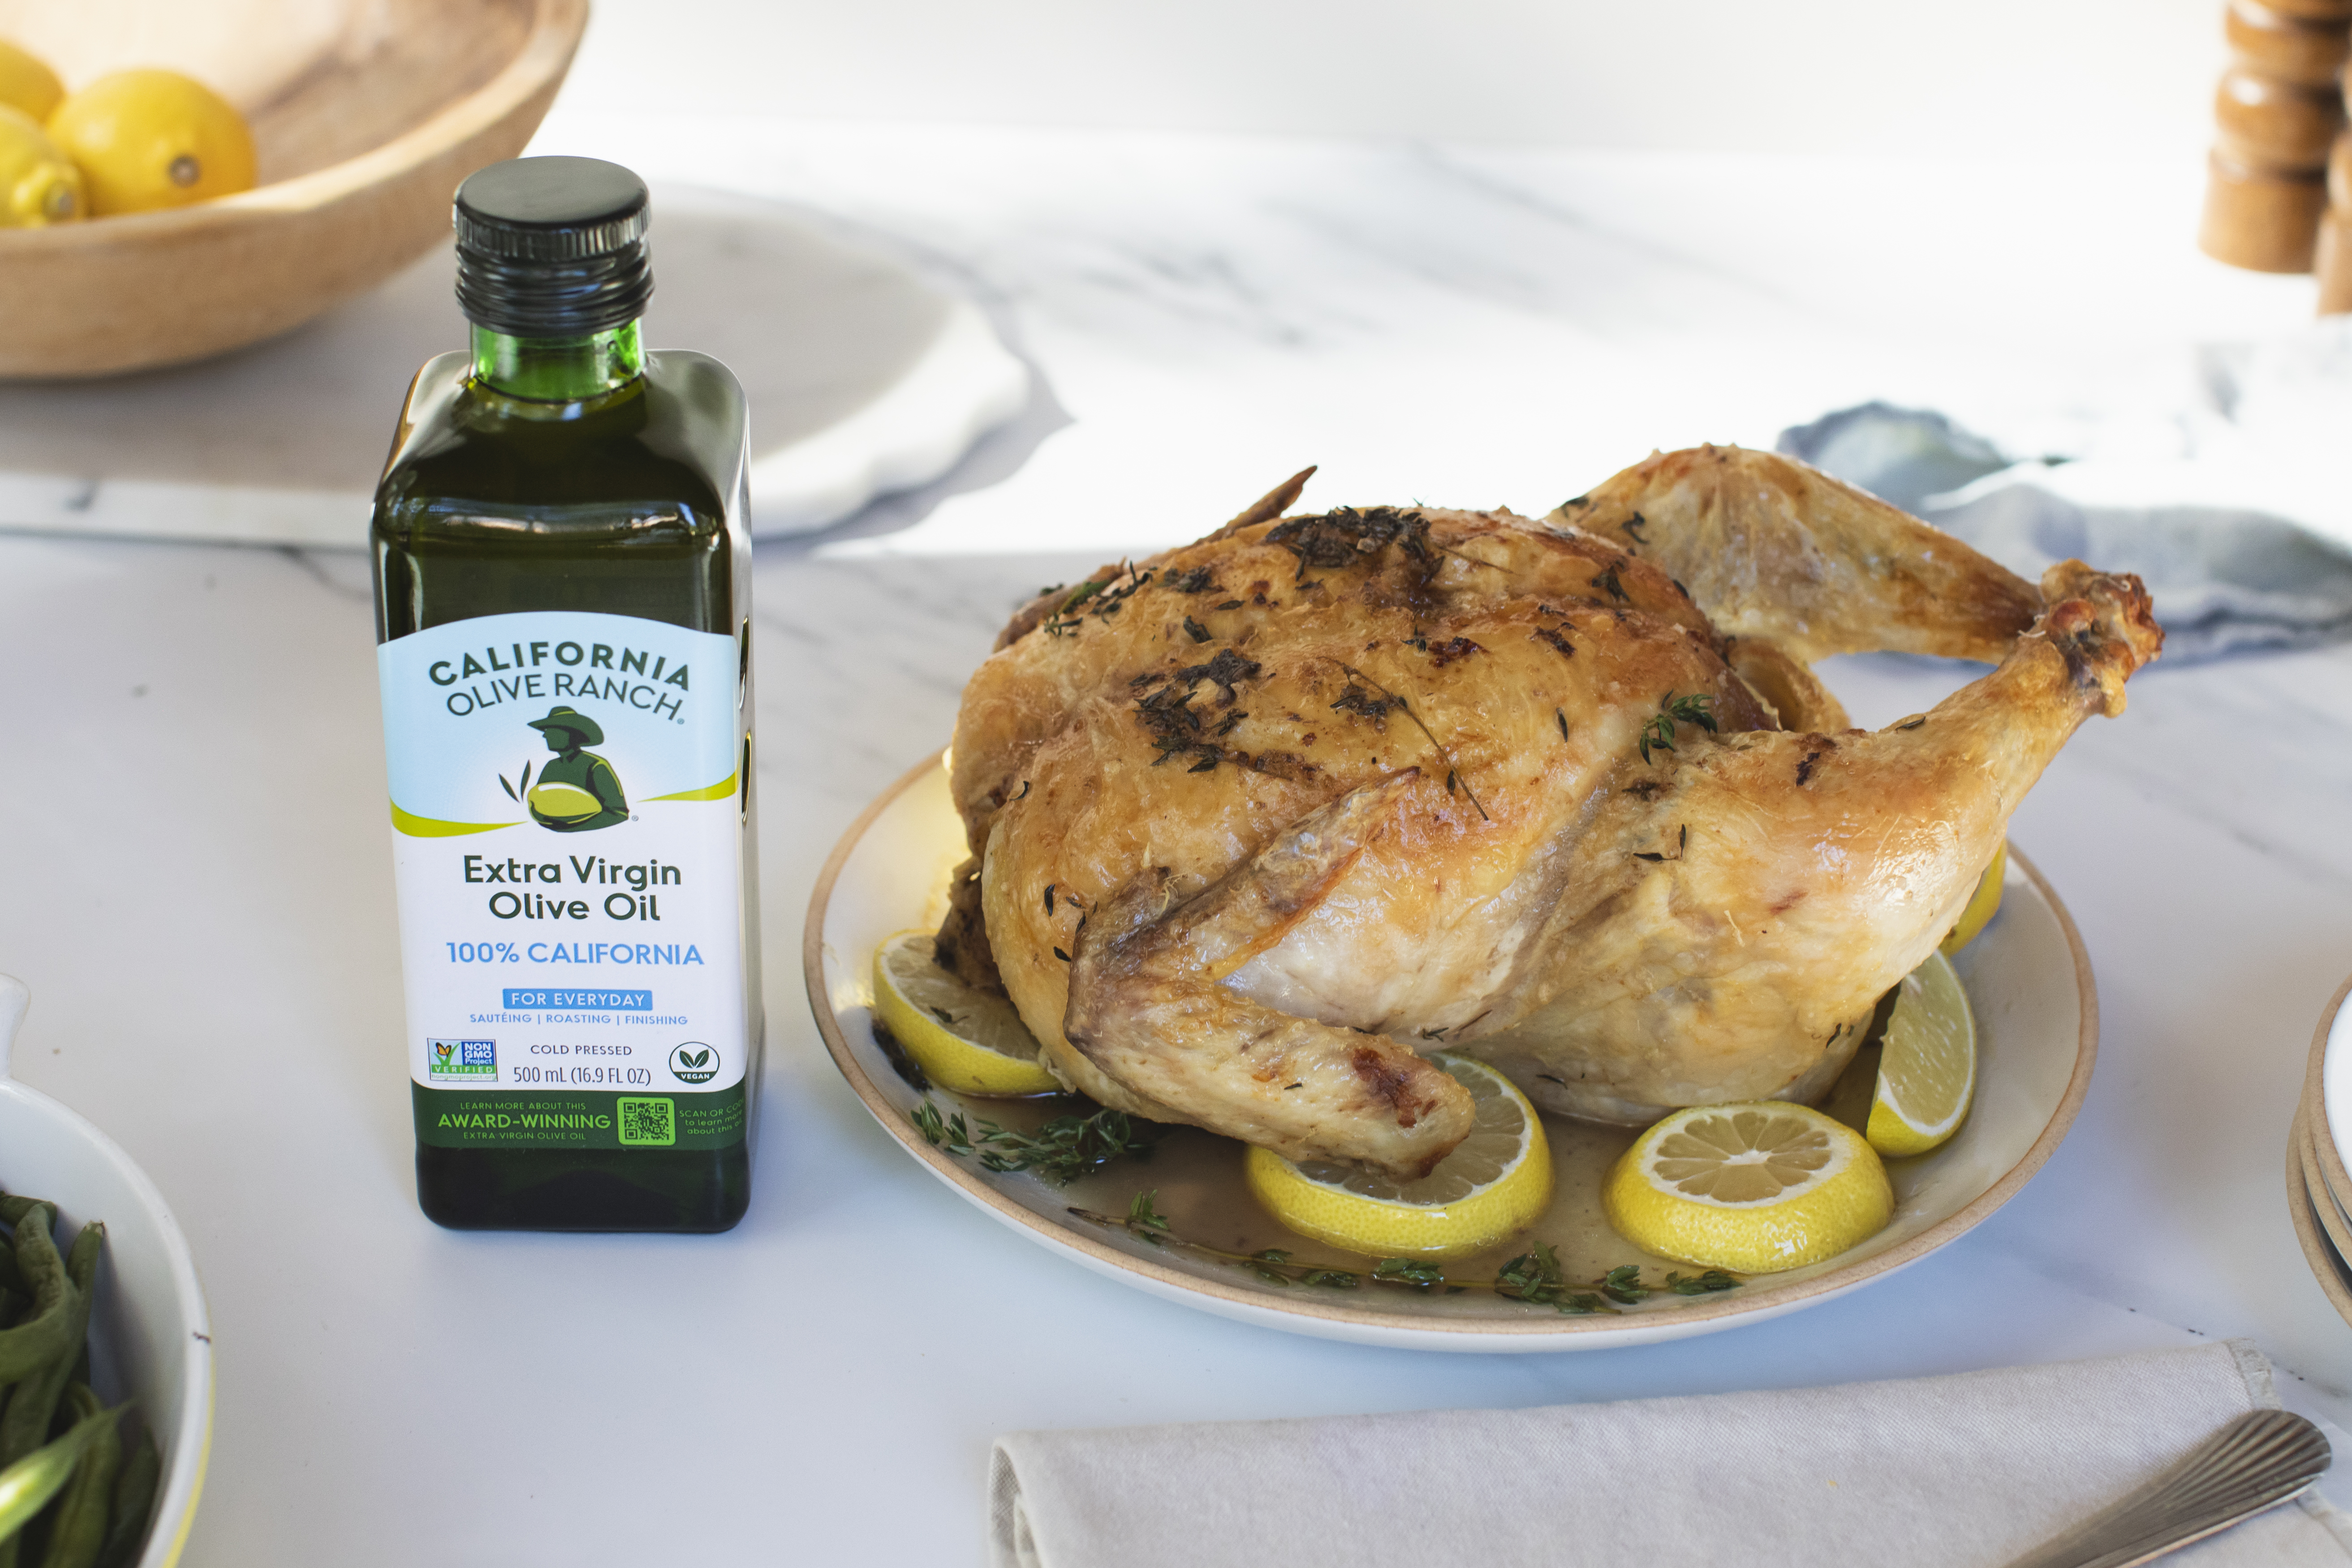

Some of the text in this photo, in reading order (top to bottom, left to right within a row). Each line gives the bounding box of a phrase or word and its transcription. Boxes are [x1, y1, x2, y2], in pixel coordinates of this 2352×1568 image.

[429, 641, 689, 692] CALIFORNIA
[447, 673, 546, 716] OLIVE
[464, 855, 681, 892] Extra Virgin
[489, 891, 660, 921] Olive Oil
[446, 942, 705, 965] 100% CALIFORNIA
[512, 993, 645, 1007] FOR EVERYDAY
[470, 1012, 532, 1023] SAUTÉING
[546, 1014, 611, 1024] ROASTING
[625, 1015, 688, 1025] FINISHING
[465, 1042, 491, 1051] NON
[530, 1045, 632, 1055] COLD PRESSED
[465, 1057, 492, 1065] Project
[514, 1067, 651, 1086] 500 mL (16.9 FL OZ)
[566, 1102, 586, 1110] THIS
[679, 1109, 706, 1117] SCAN
[438, 1114, 611, 1129] AWARD-WINNING
[718, 1124, 732, 1133] this
